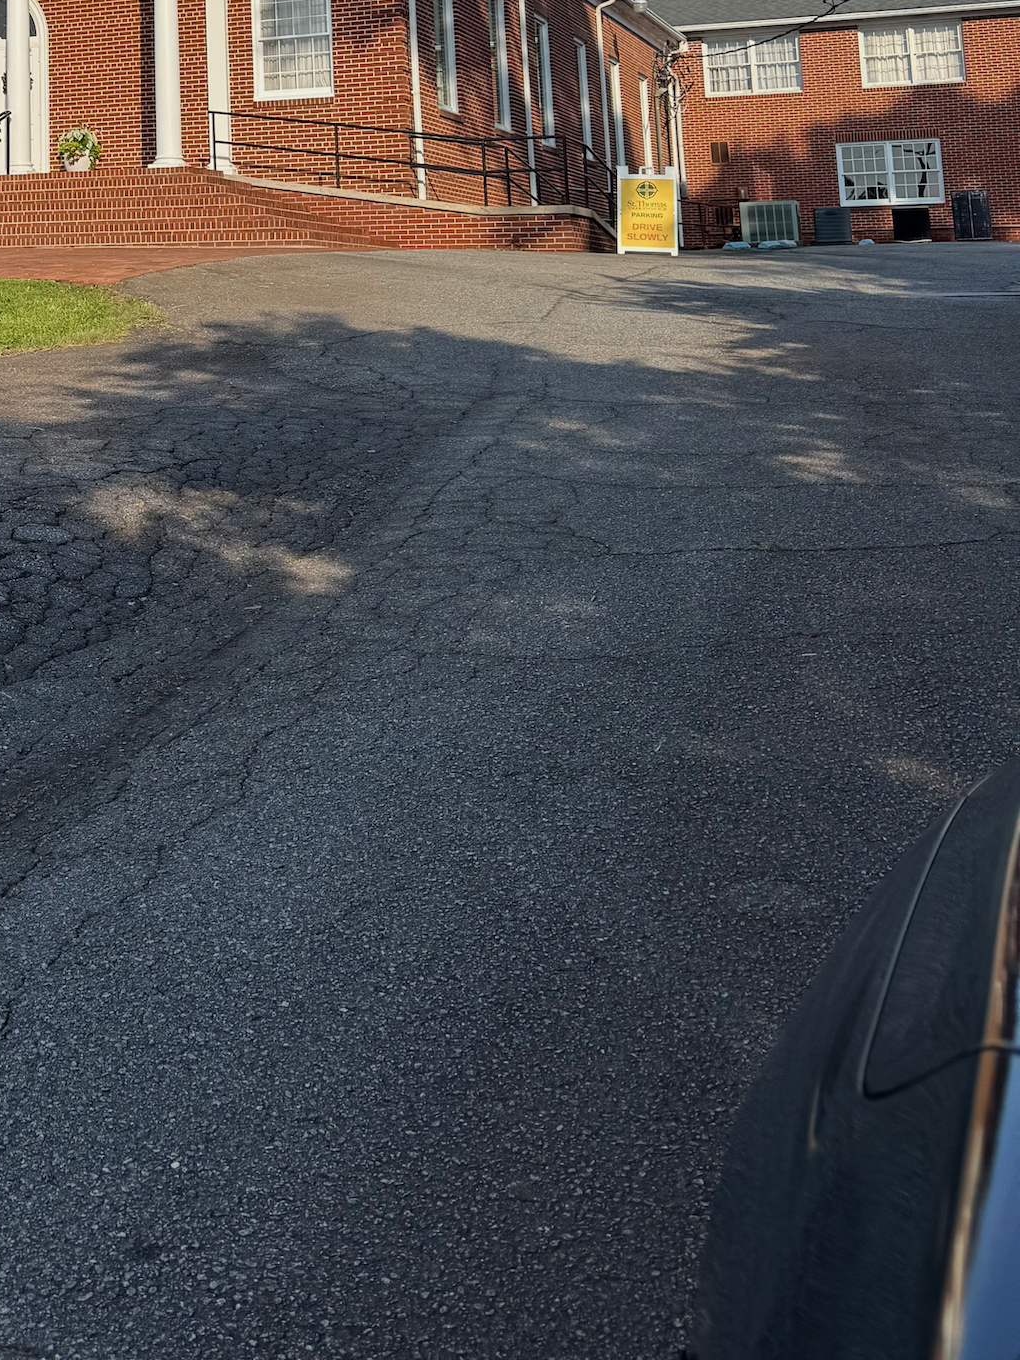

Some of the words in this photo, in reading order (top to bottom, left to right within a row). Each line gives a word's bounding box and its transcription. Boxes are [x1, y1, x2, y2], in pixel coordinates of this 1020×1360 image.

[637, 200, 667, 208] Thomas
[632, 223, 663, 231] DRIVE
[627, 233, 669, 241] SLOWLY
